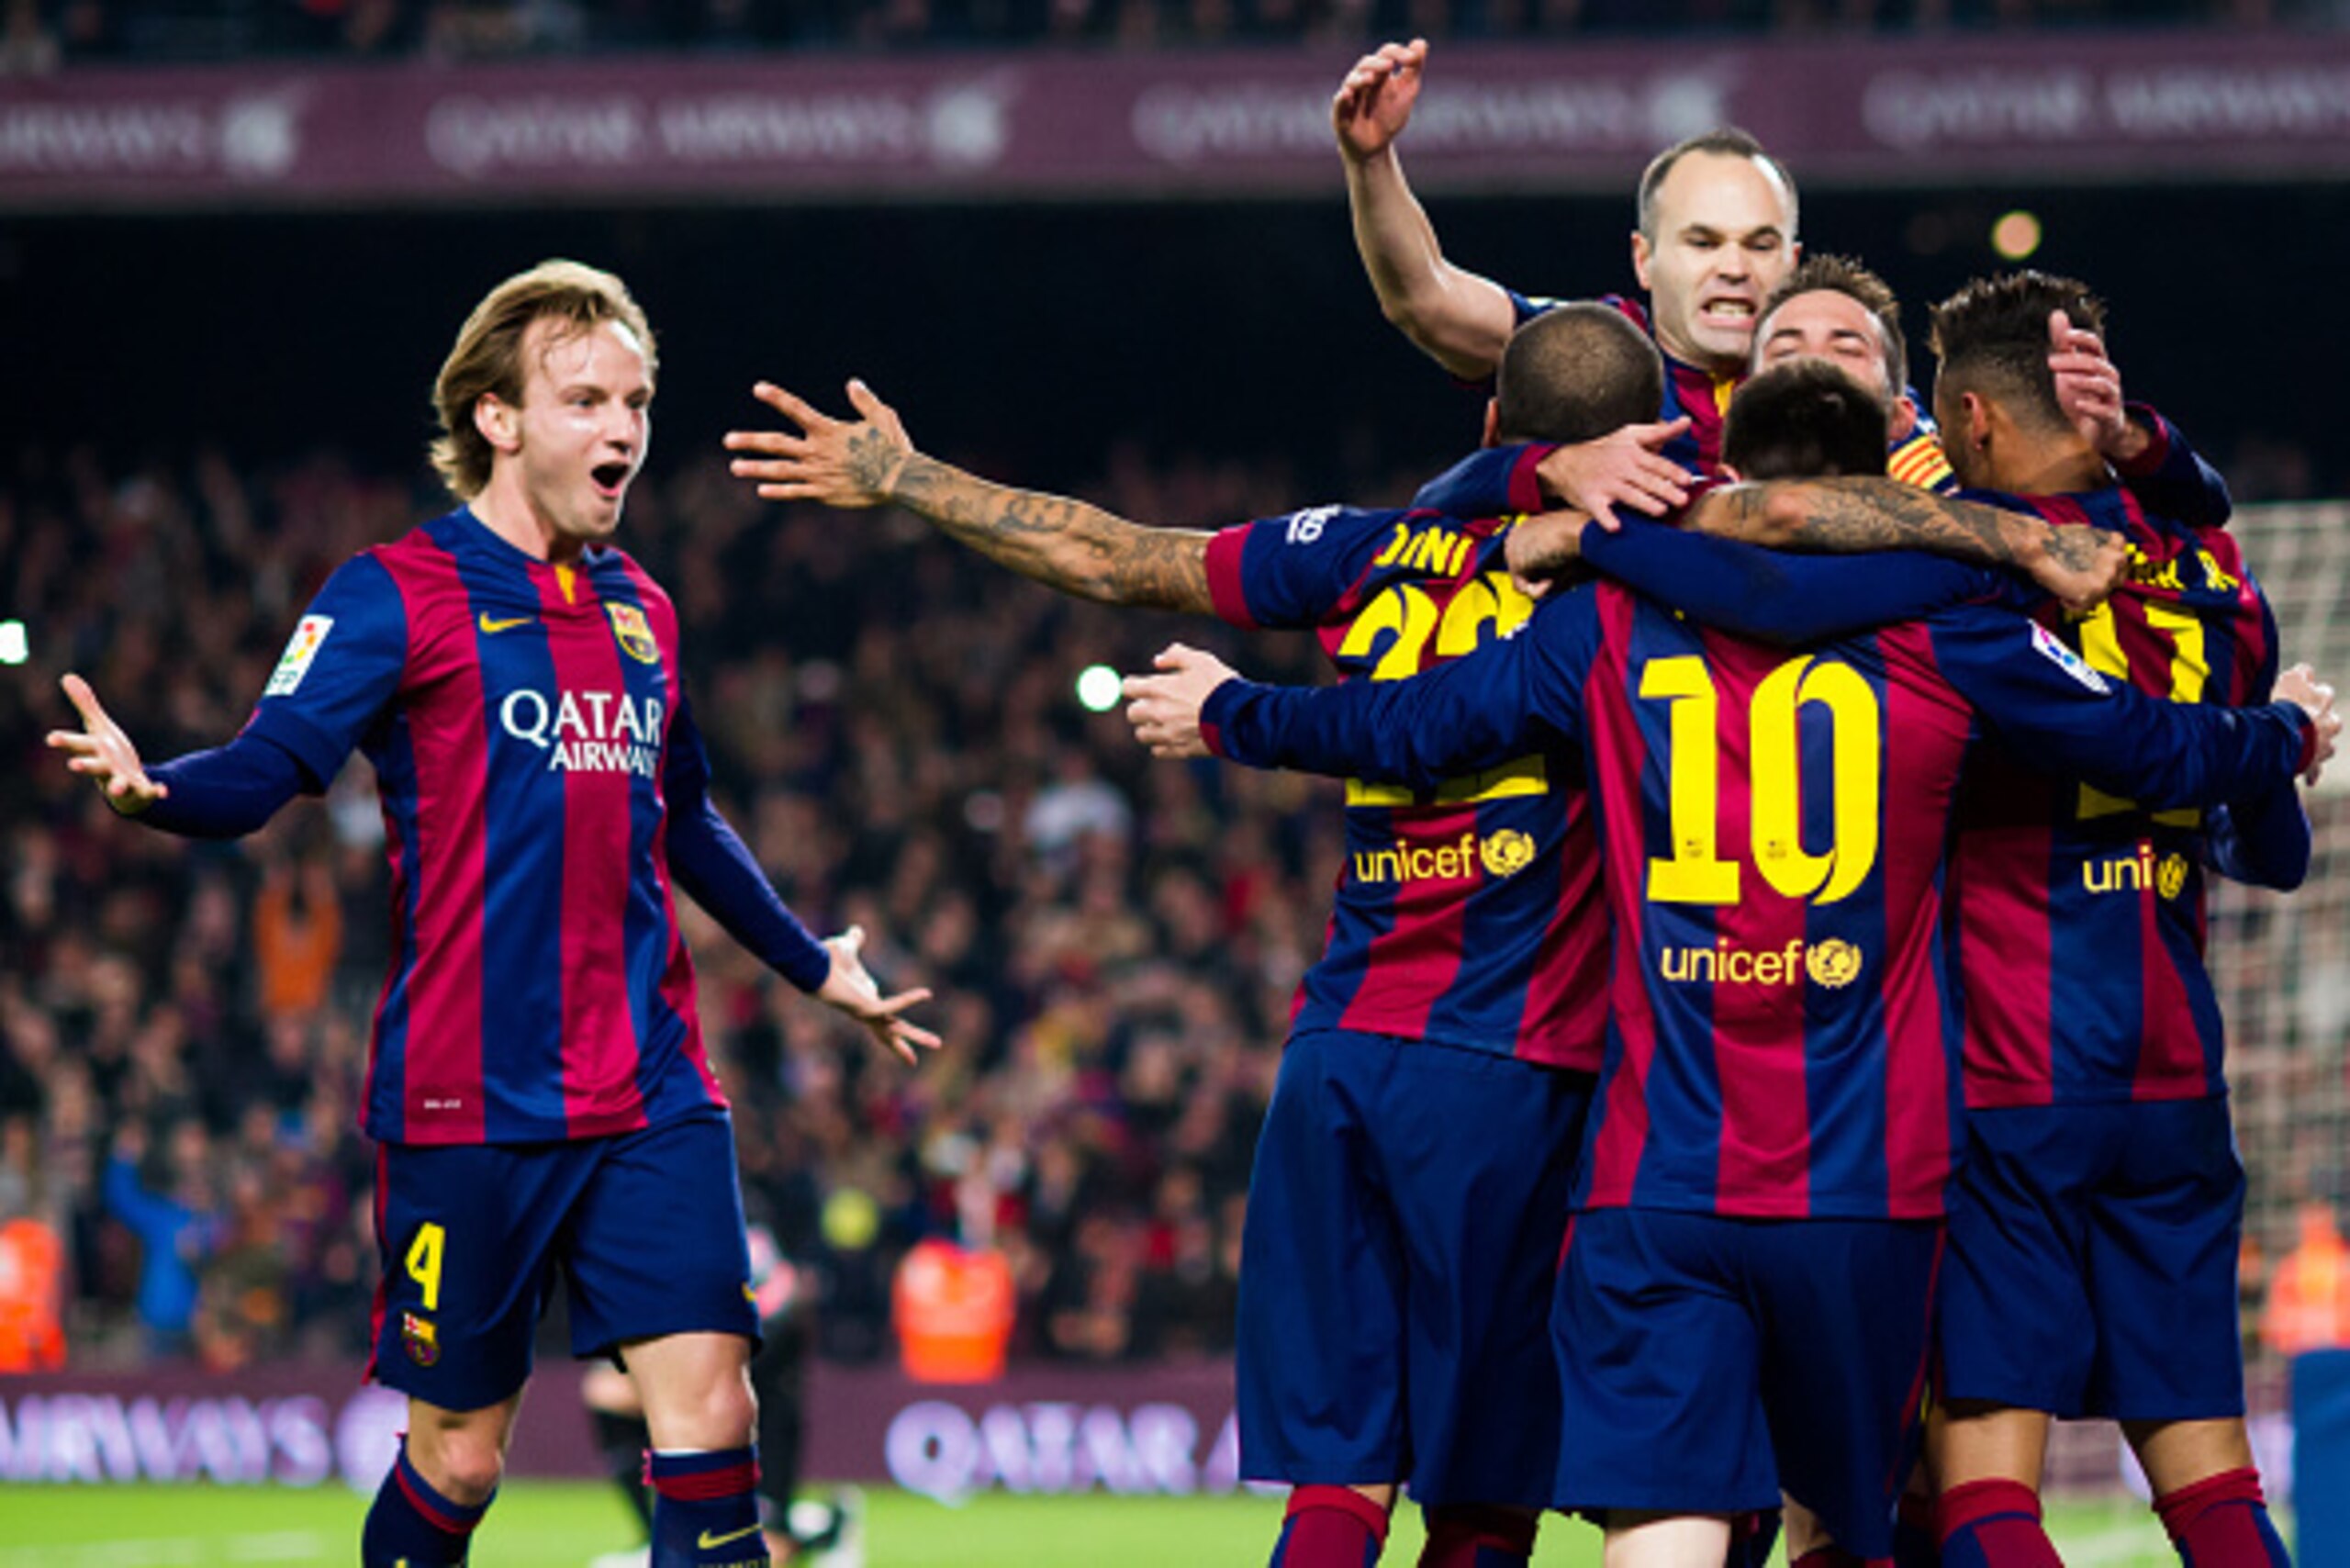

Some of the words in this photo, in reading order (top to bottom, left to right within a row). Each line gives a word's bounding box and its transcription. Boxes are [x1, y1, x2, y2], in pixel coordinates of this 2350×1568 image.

[499, 689, 663, 748] QATAR
[1639, 654, 1880, 906] 10
[1354, 832, 1477, 883] unicef
[1659, 935, 1804, 985] unicef
[404, 1221, 445, 1311] 4
[884, 1400, 1199, 1508] QATAR
